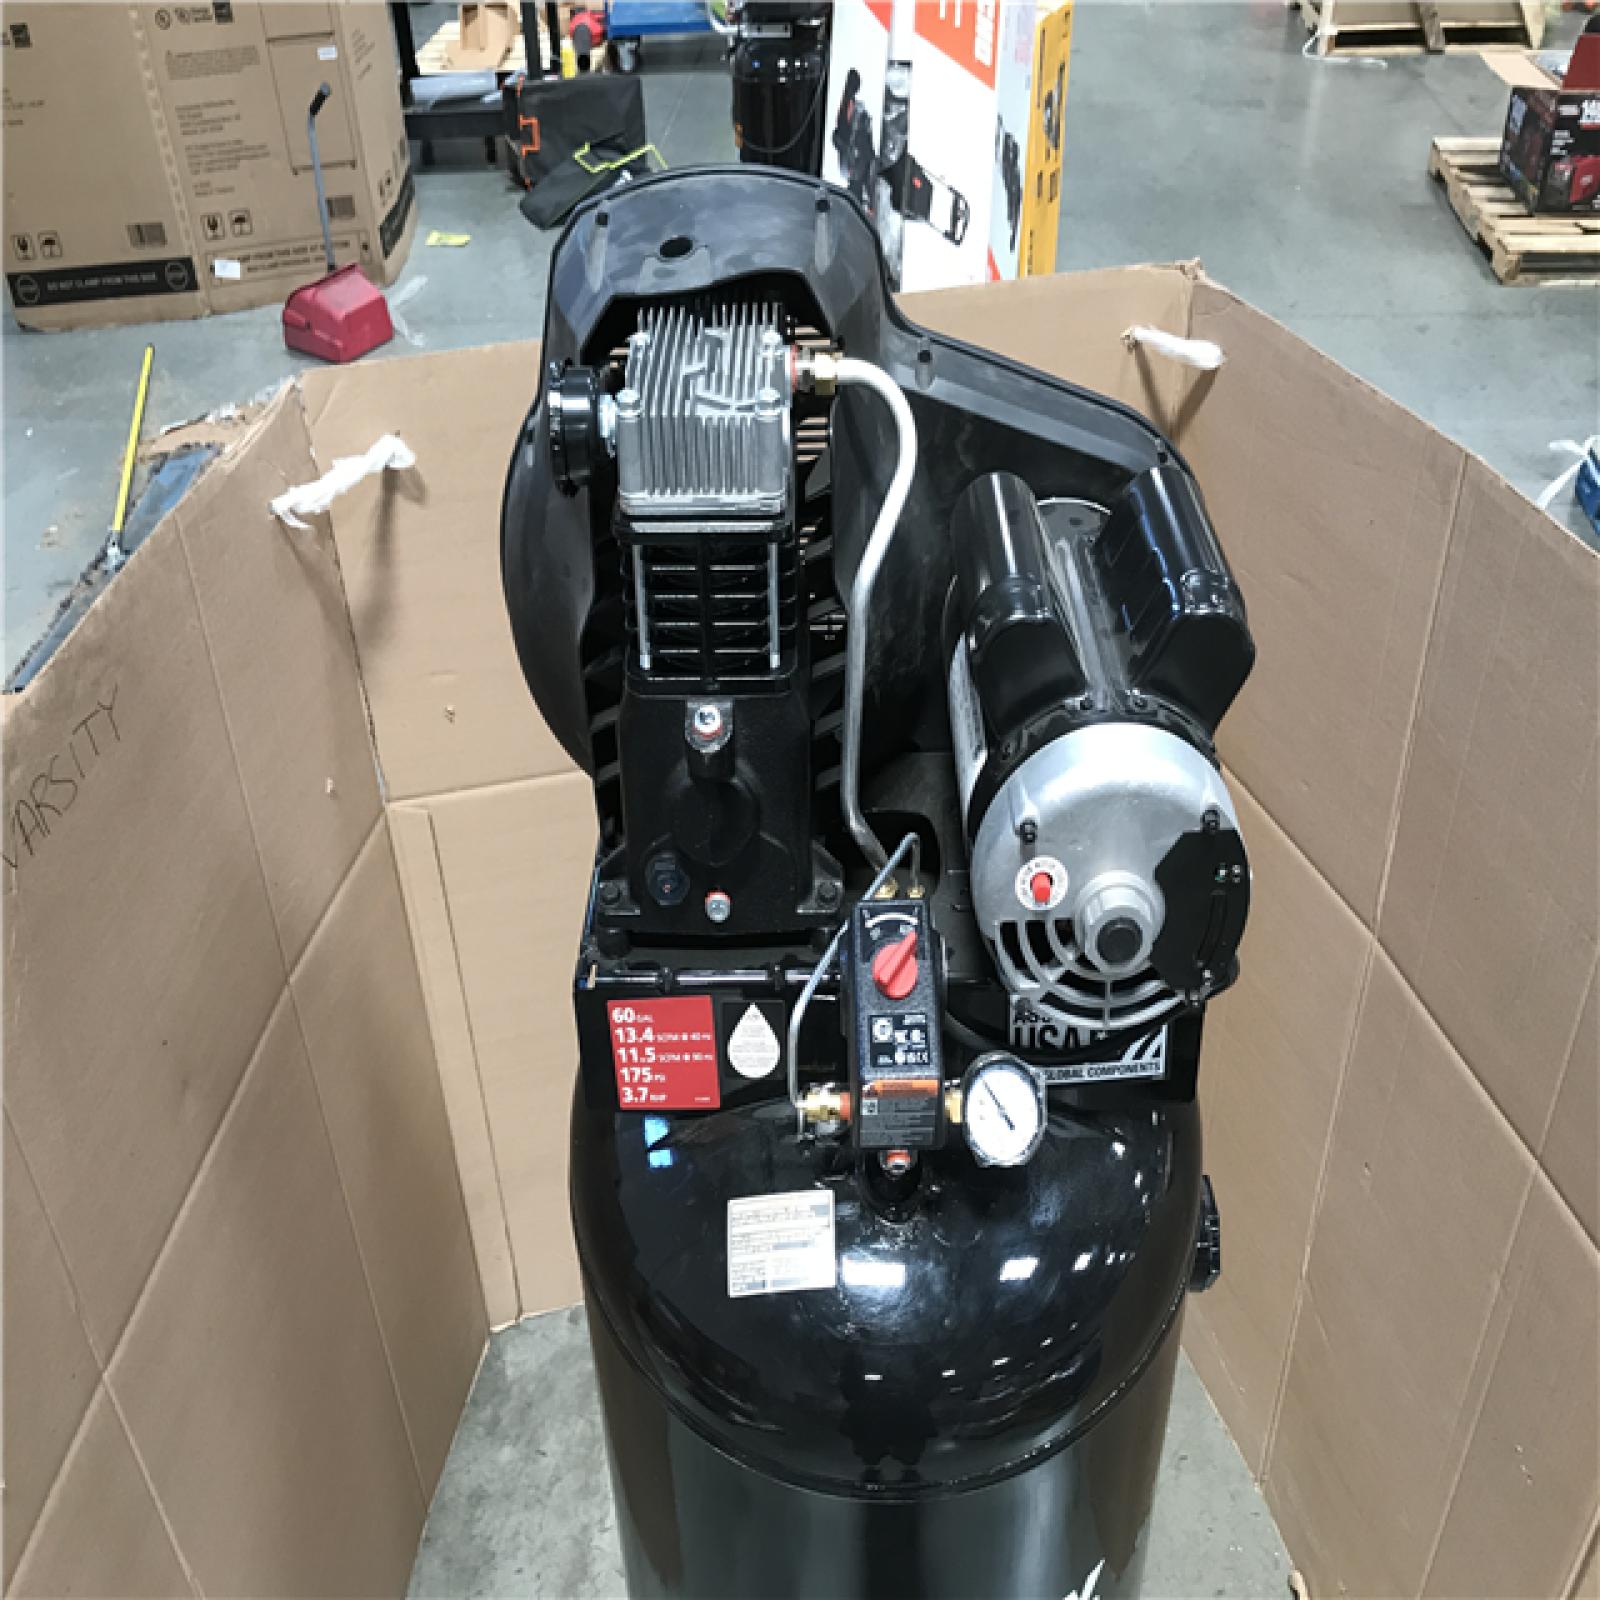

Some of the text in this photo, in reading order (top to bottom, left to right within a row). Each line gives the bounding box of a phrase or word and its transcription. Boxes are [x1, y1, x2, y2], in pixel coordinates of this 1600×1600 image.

[612, 1007, 635, 1023] 60
[614, 1027, 654, 1043] 13.4
[617, 1047, 656, 1063] 11.5
[620, 1067, 653, 1083] 175
[1044, 1069, 1083, 1081] GLOBAL
[1087, 1061, 1161, 1078] COMPONENTS
[622, 1087, 648, 1103] 3.7
